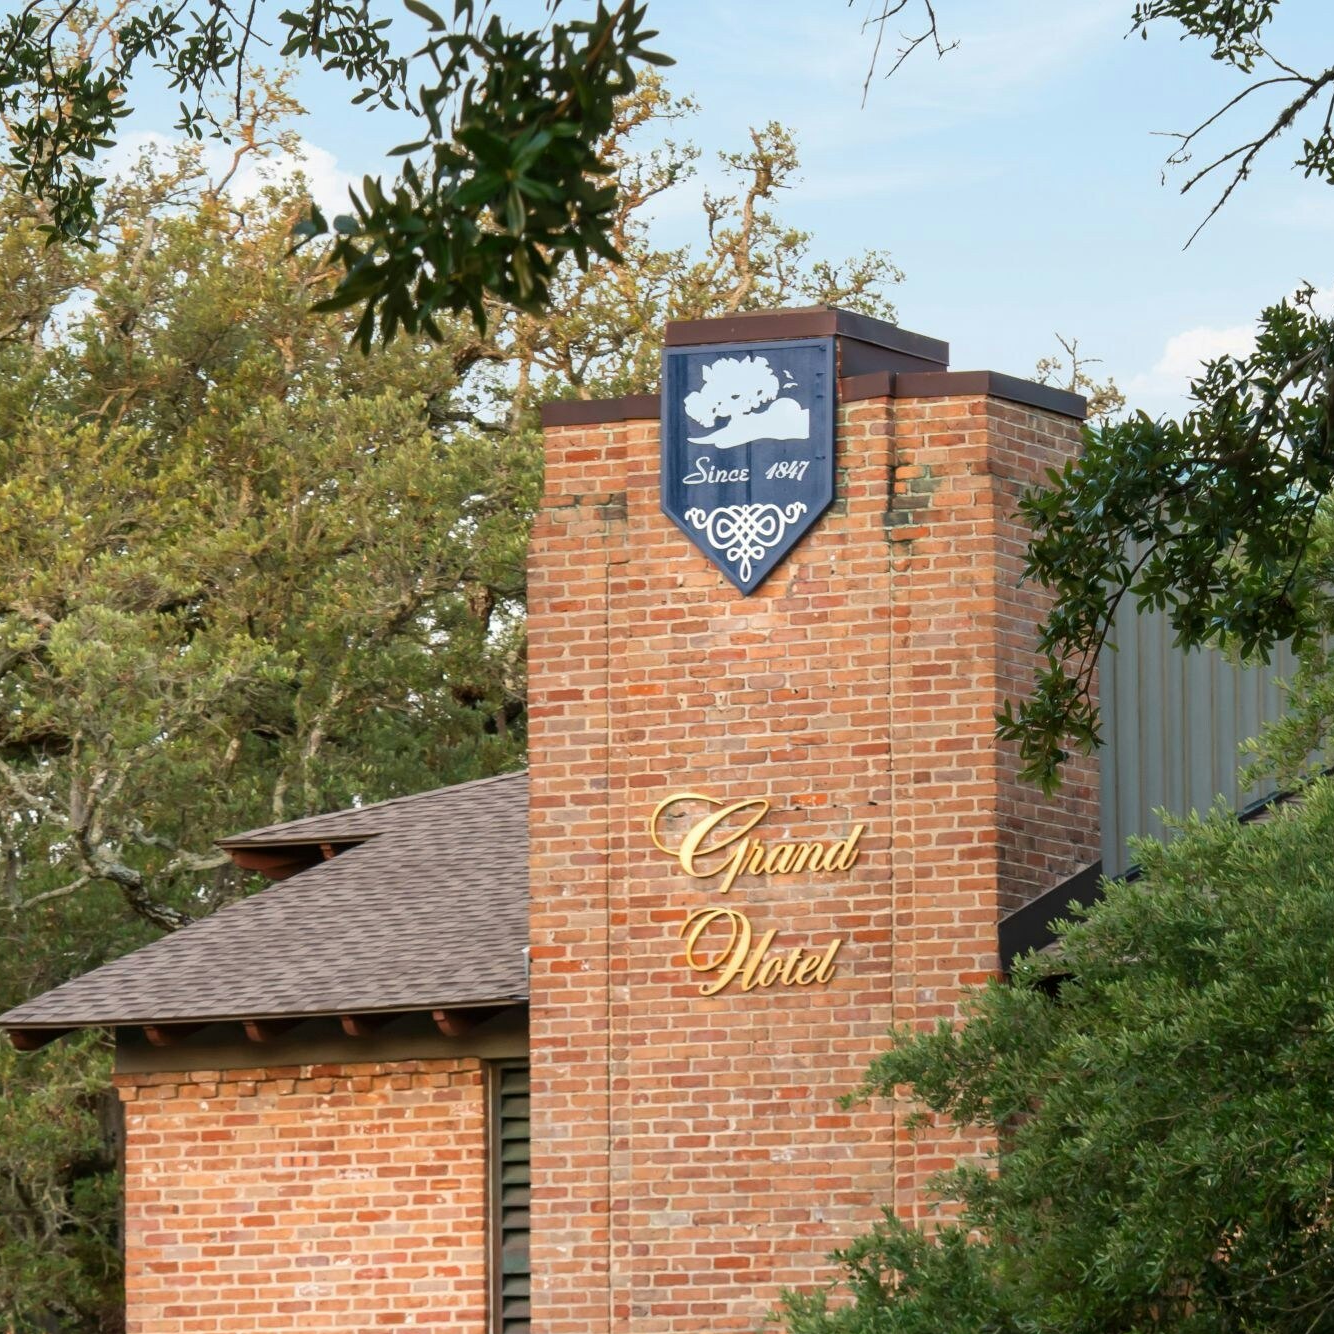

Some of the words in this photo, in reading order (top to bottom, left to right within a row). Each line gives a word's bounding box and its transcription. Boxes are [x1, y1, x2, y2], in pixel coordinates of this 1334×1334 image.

[682, 456, 750, 485] Since
[765, 461, 810, 481] 1847
[650, 792, 866, 893] Grand
[678, 907, 842, 996] Hotel
